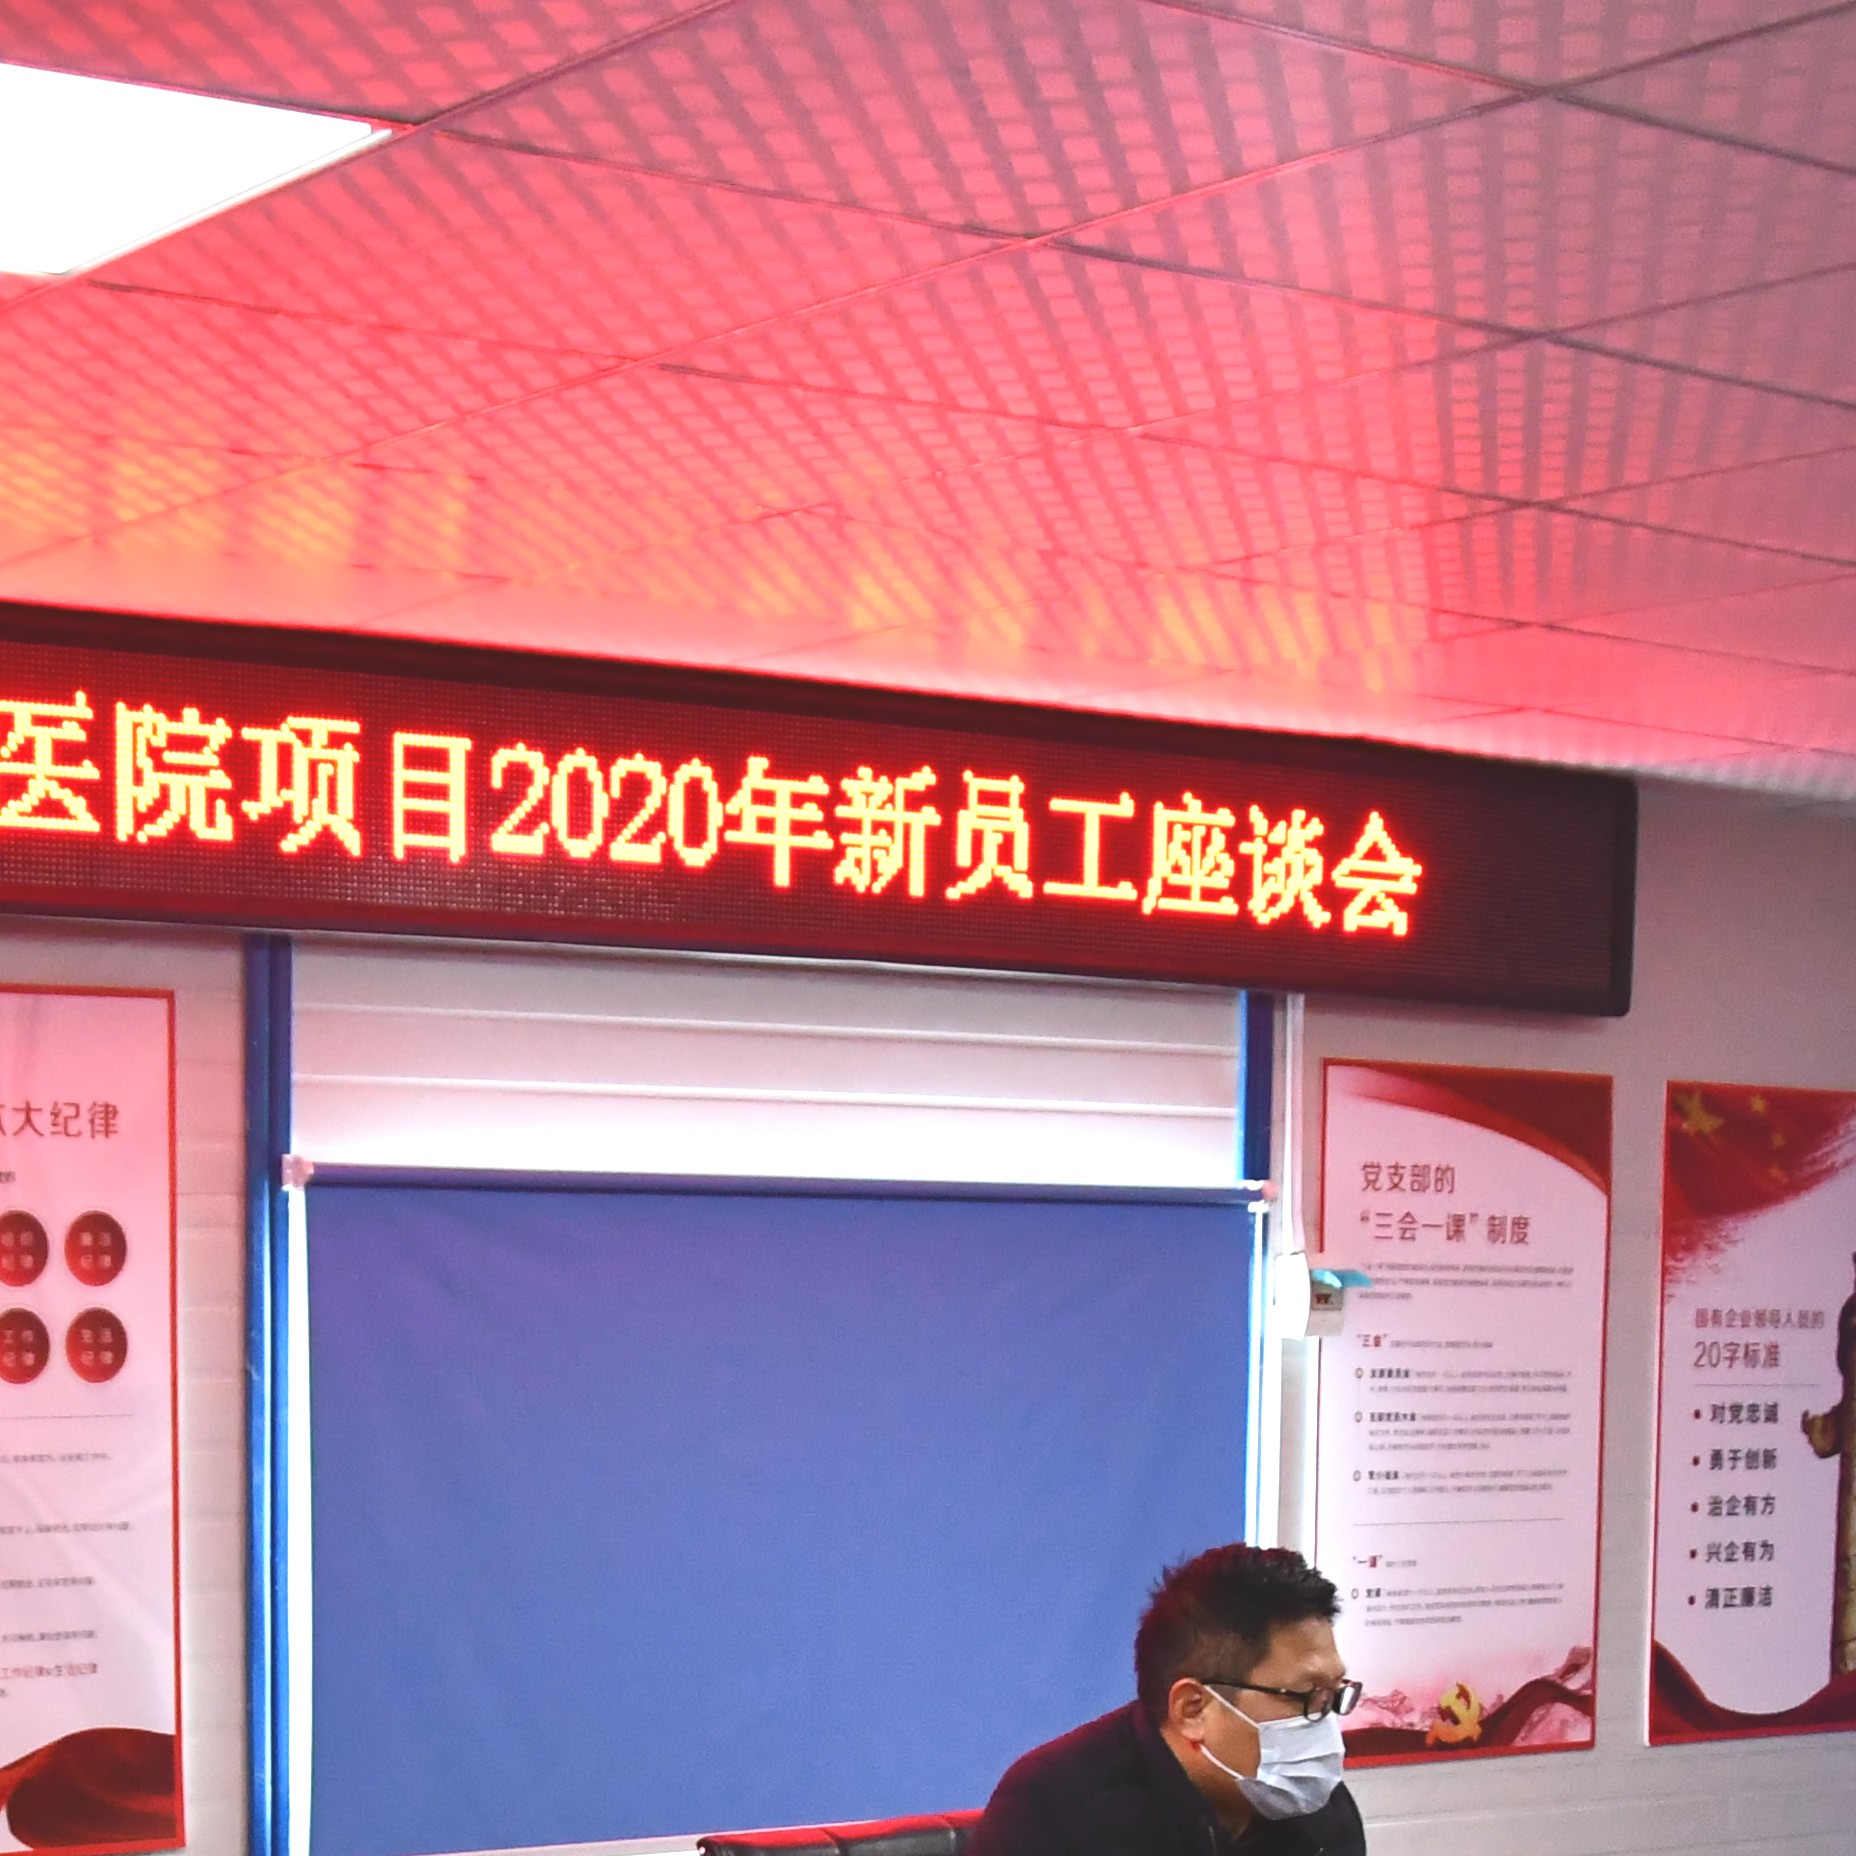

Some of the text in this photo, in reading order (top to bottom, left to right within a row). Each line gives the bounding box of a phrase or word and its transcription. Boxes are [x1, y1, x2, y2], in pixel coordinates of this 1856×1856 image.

[1360, 1161, 1456, 1194] 党支部的
[1360, 1210, 1531, 1245] “三会一课”制度
[1694, 1308, 1825, 1330] 国有企业领导人员的
[1693, 1341, 1780, 1369] 20字标准
[1709, 1403, 1780, 1426] 对党忠诚
[1709, 1448, 1778, 1473] 勇于创新
[1706, 1494, 1776, 1518] 治企有方
[1705, 1540, 1775, 1564] 兴企有为
